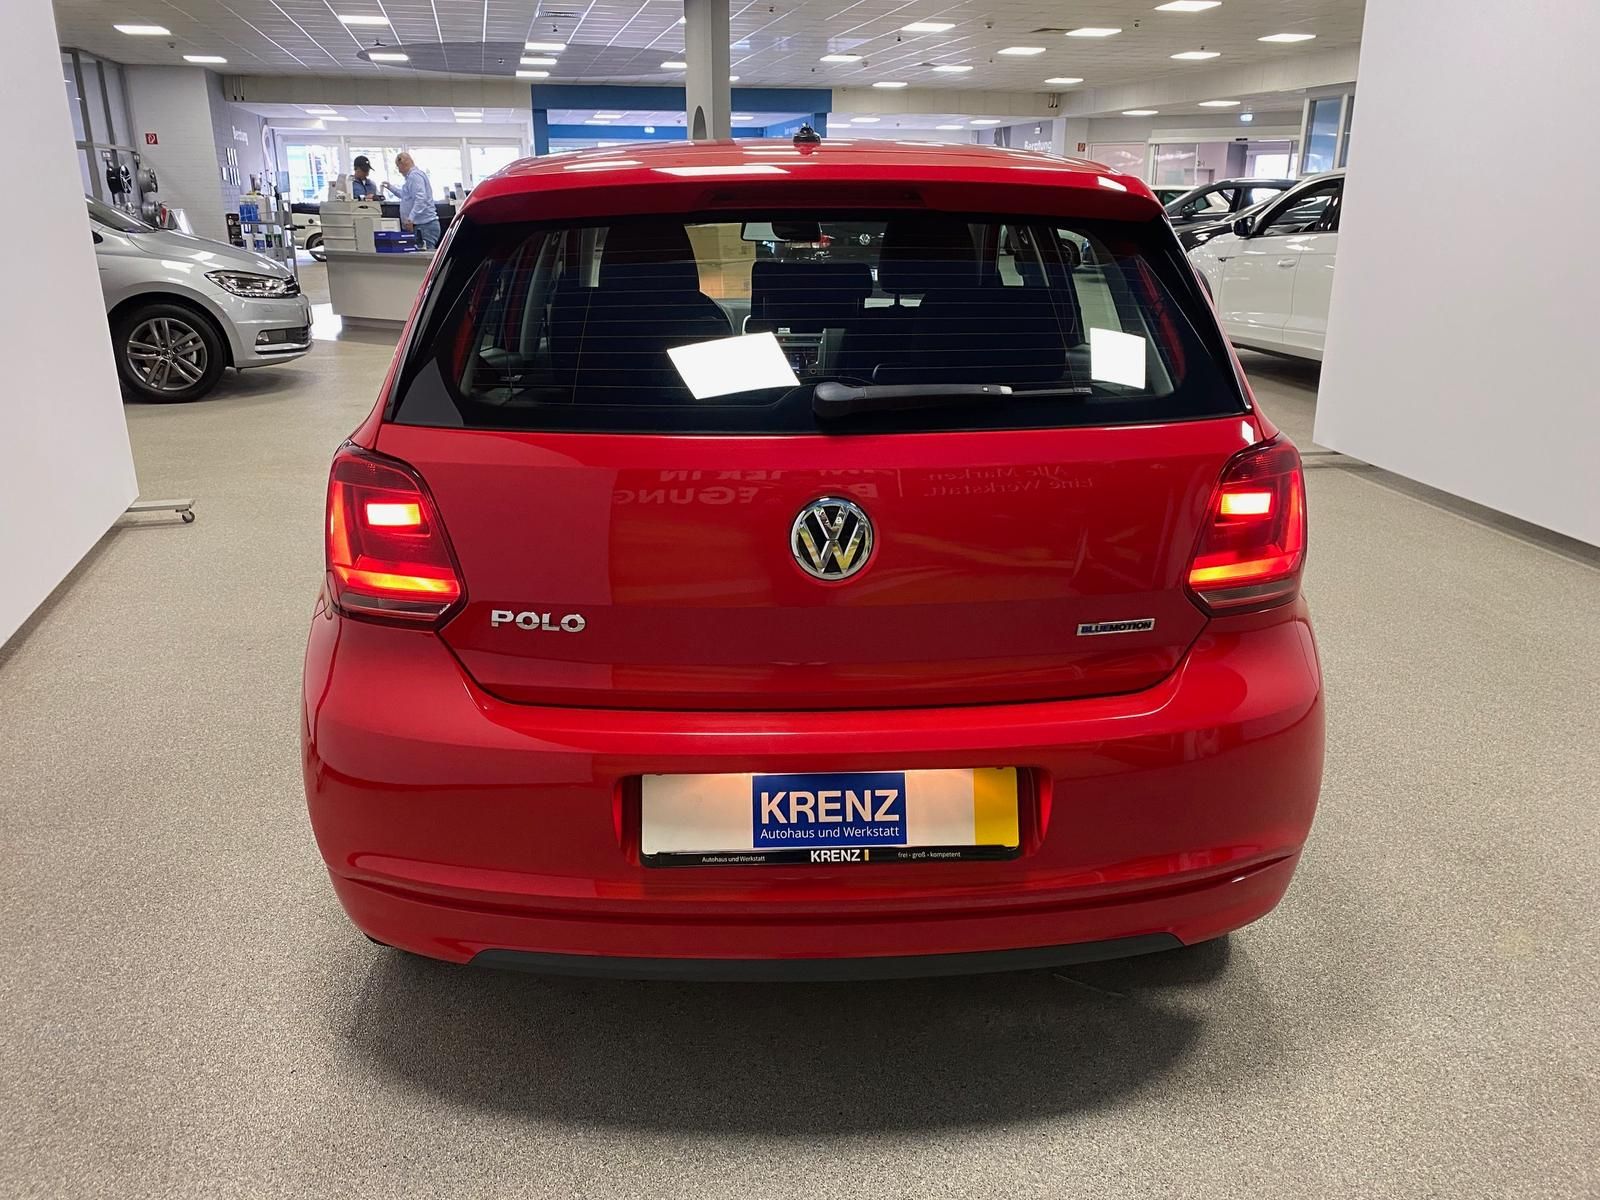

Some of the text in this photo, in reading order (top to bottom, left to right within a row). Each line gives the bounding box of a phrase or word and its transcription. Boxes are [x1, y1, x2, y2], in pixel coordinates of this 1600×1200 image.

[791, 496, 873, 580] VW
[491, 609, 586, 633] POLO
[1080, 621, 1152, 634] BLUEMOTION
[760, 789, 900, 824] KRENZ
[760, 826, 900, 839] Autohaus und Werkstatt
[810, 849, 860, 863] KRENZ
[912, 851, 926, 859] groß
[930, 851, 961, 859] kompetent
